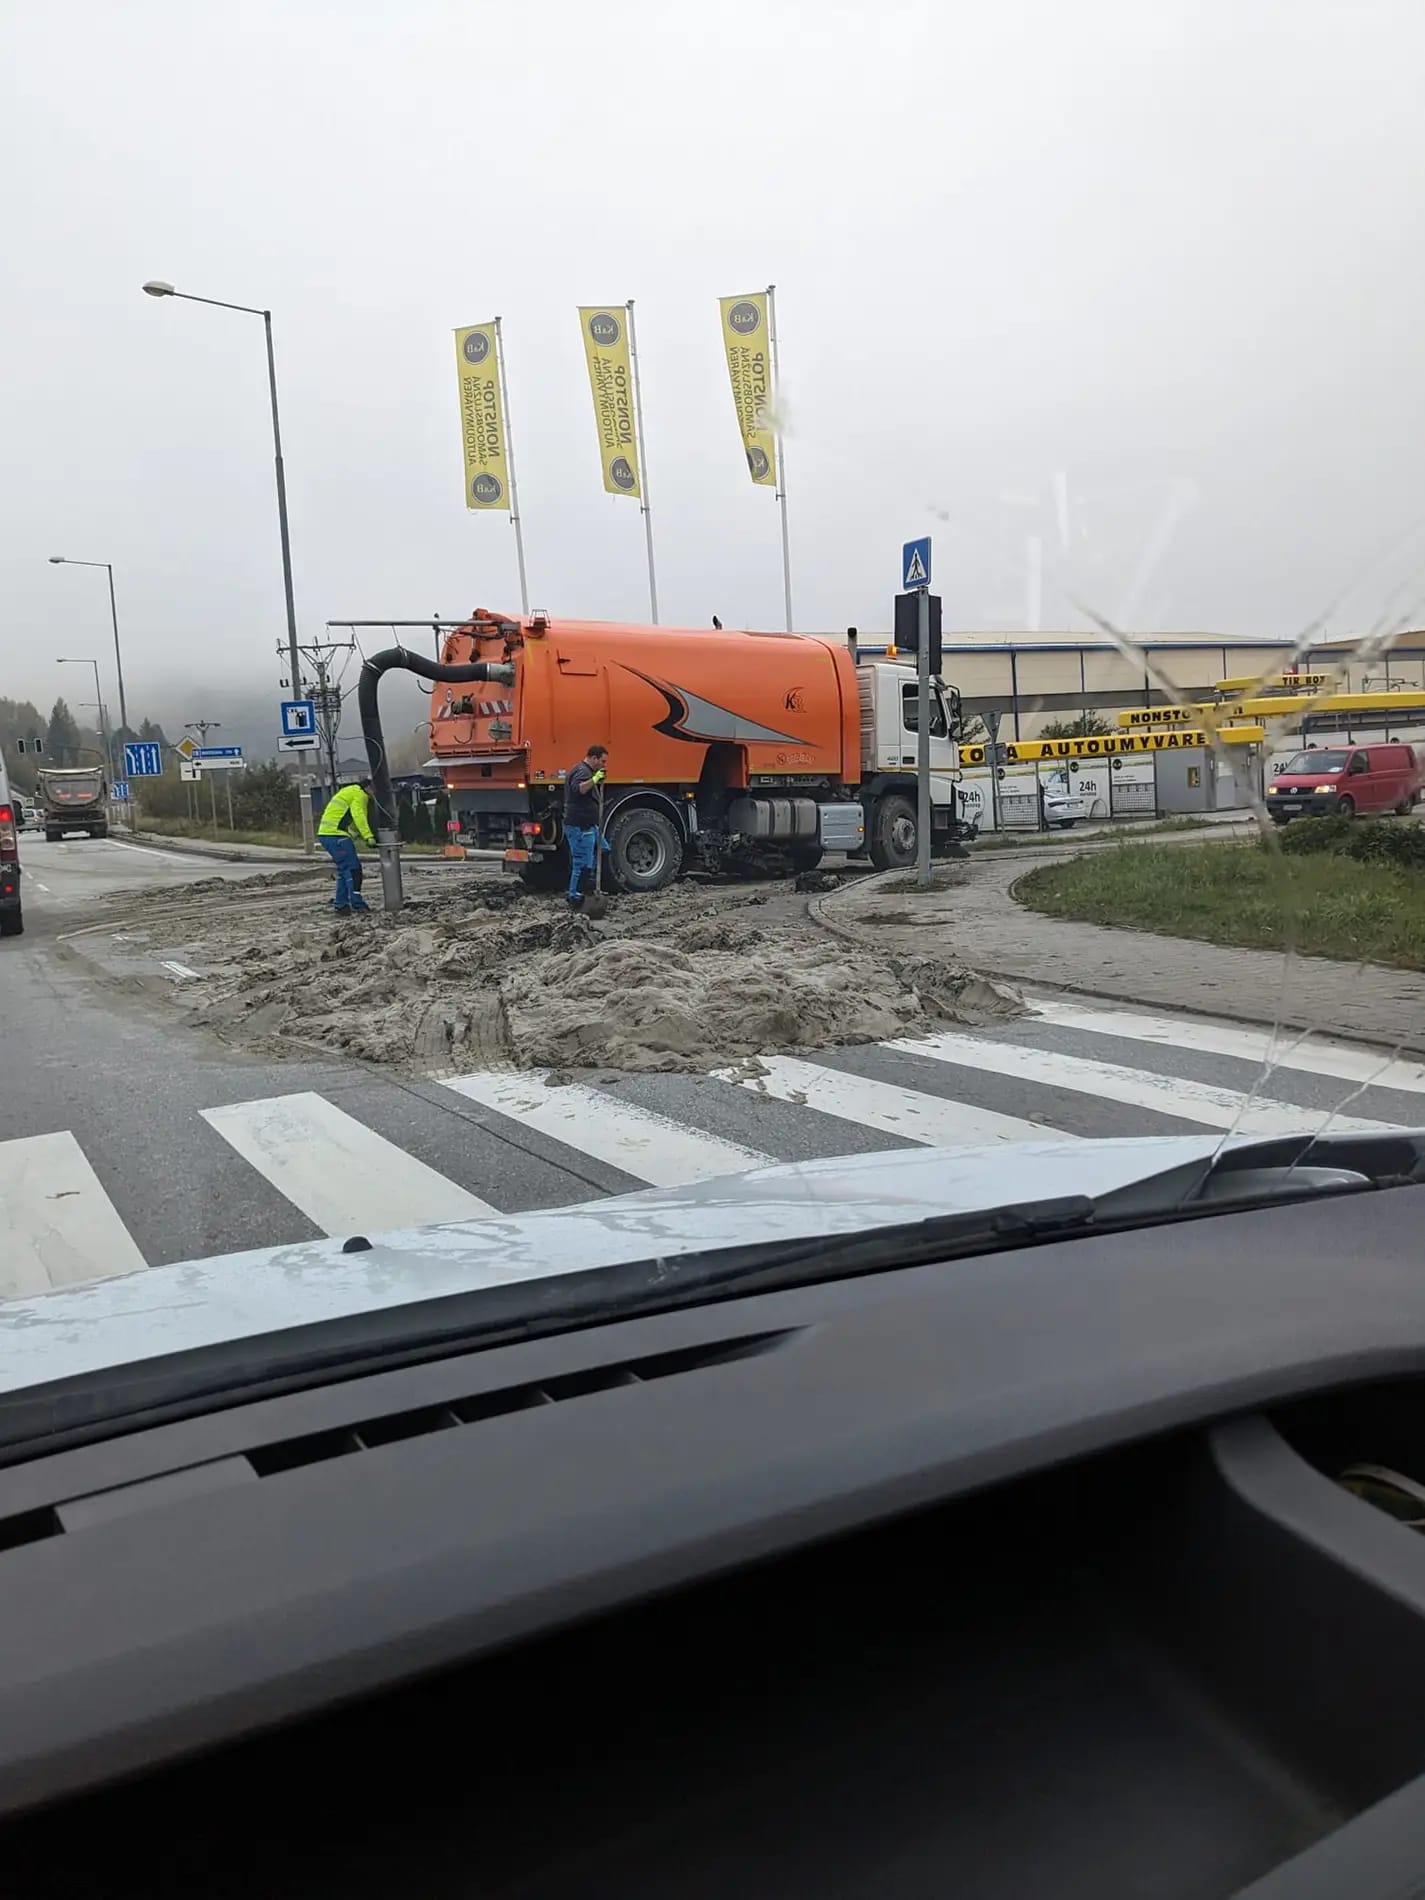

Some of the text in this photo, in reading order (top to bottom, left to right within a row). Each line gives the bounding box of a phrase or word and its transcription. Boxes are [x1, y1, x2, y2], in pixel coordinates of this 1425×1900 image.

[1131, 709, 1203, 724] NONSTO
[1079, 780, 1097, 792] 24h
[962, 791, 981, 803] 24h
